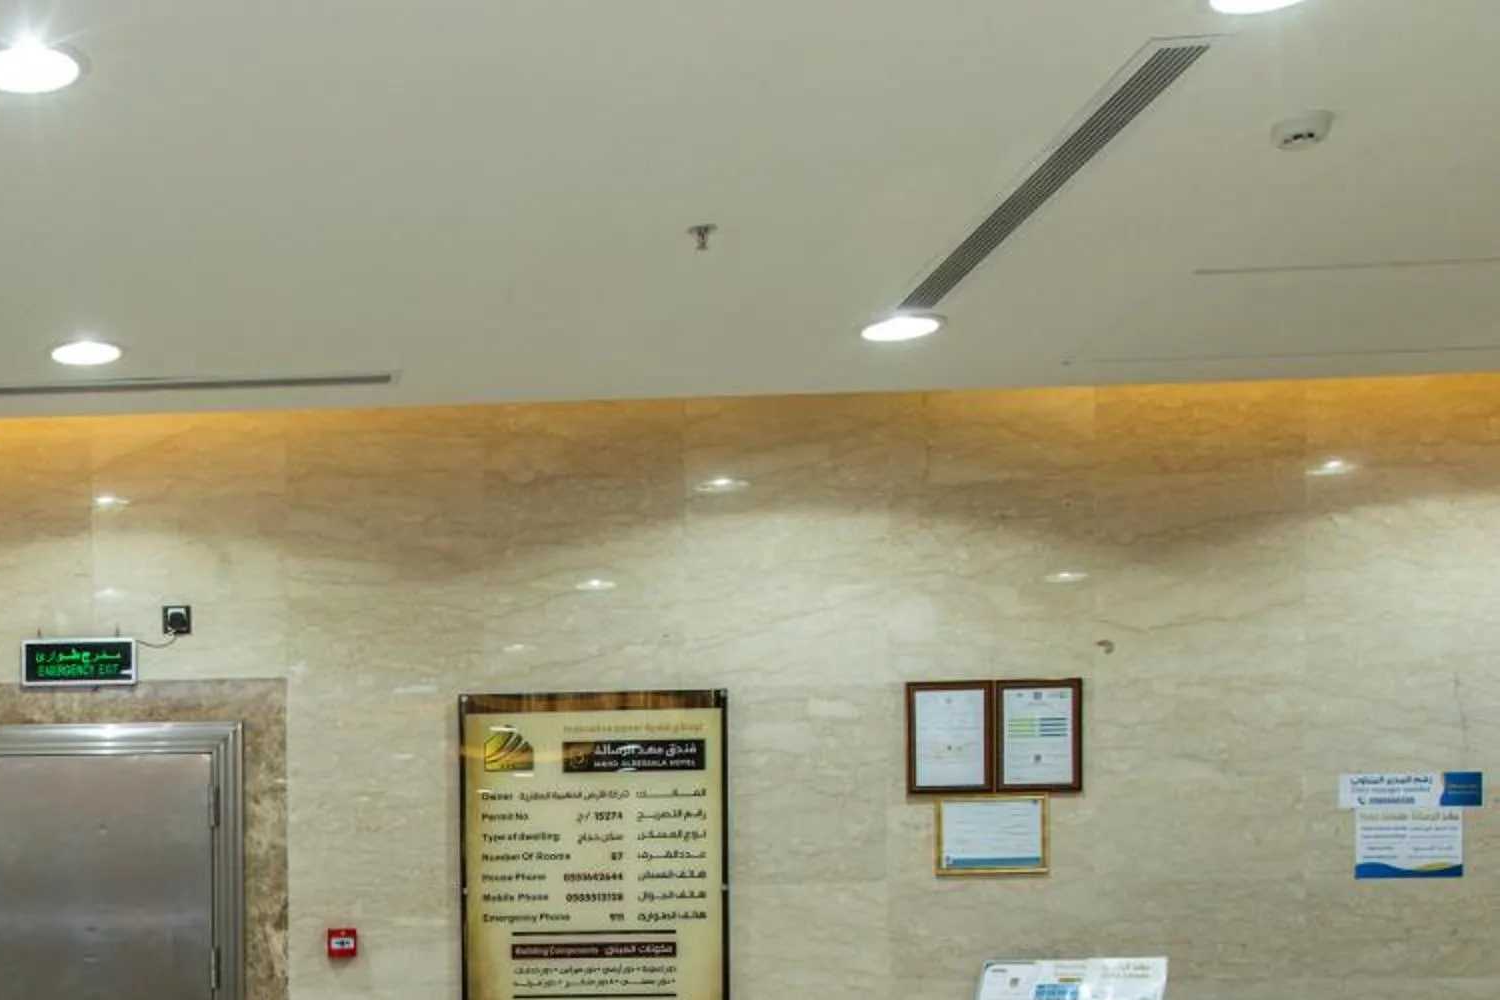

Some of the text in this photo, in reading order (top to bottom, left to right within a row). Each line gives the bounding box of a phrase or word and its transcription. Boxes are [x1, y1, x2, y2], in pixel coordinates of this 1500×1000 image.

[36, 664, 119, 676] EMERGENCY EXIT
[665, 743, 697, 757] فندق
[669, 759, 696, 767] HOTEL
[483, 833, 506, 842] Type
[482, 853, 571, 861] Number Of Rooms
[515, 873, 547, 881] Phone
[482, 893, 514, 902] Mobile
[517, 893, 549, 901] Phone
[483, 914, 538, 923] Emergency
[539, 913, 571, 921] Phone
